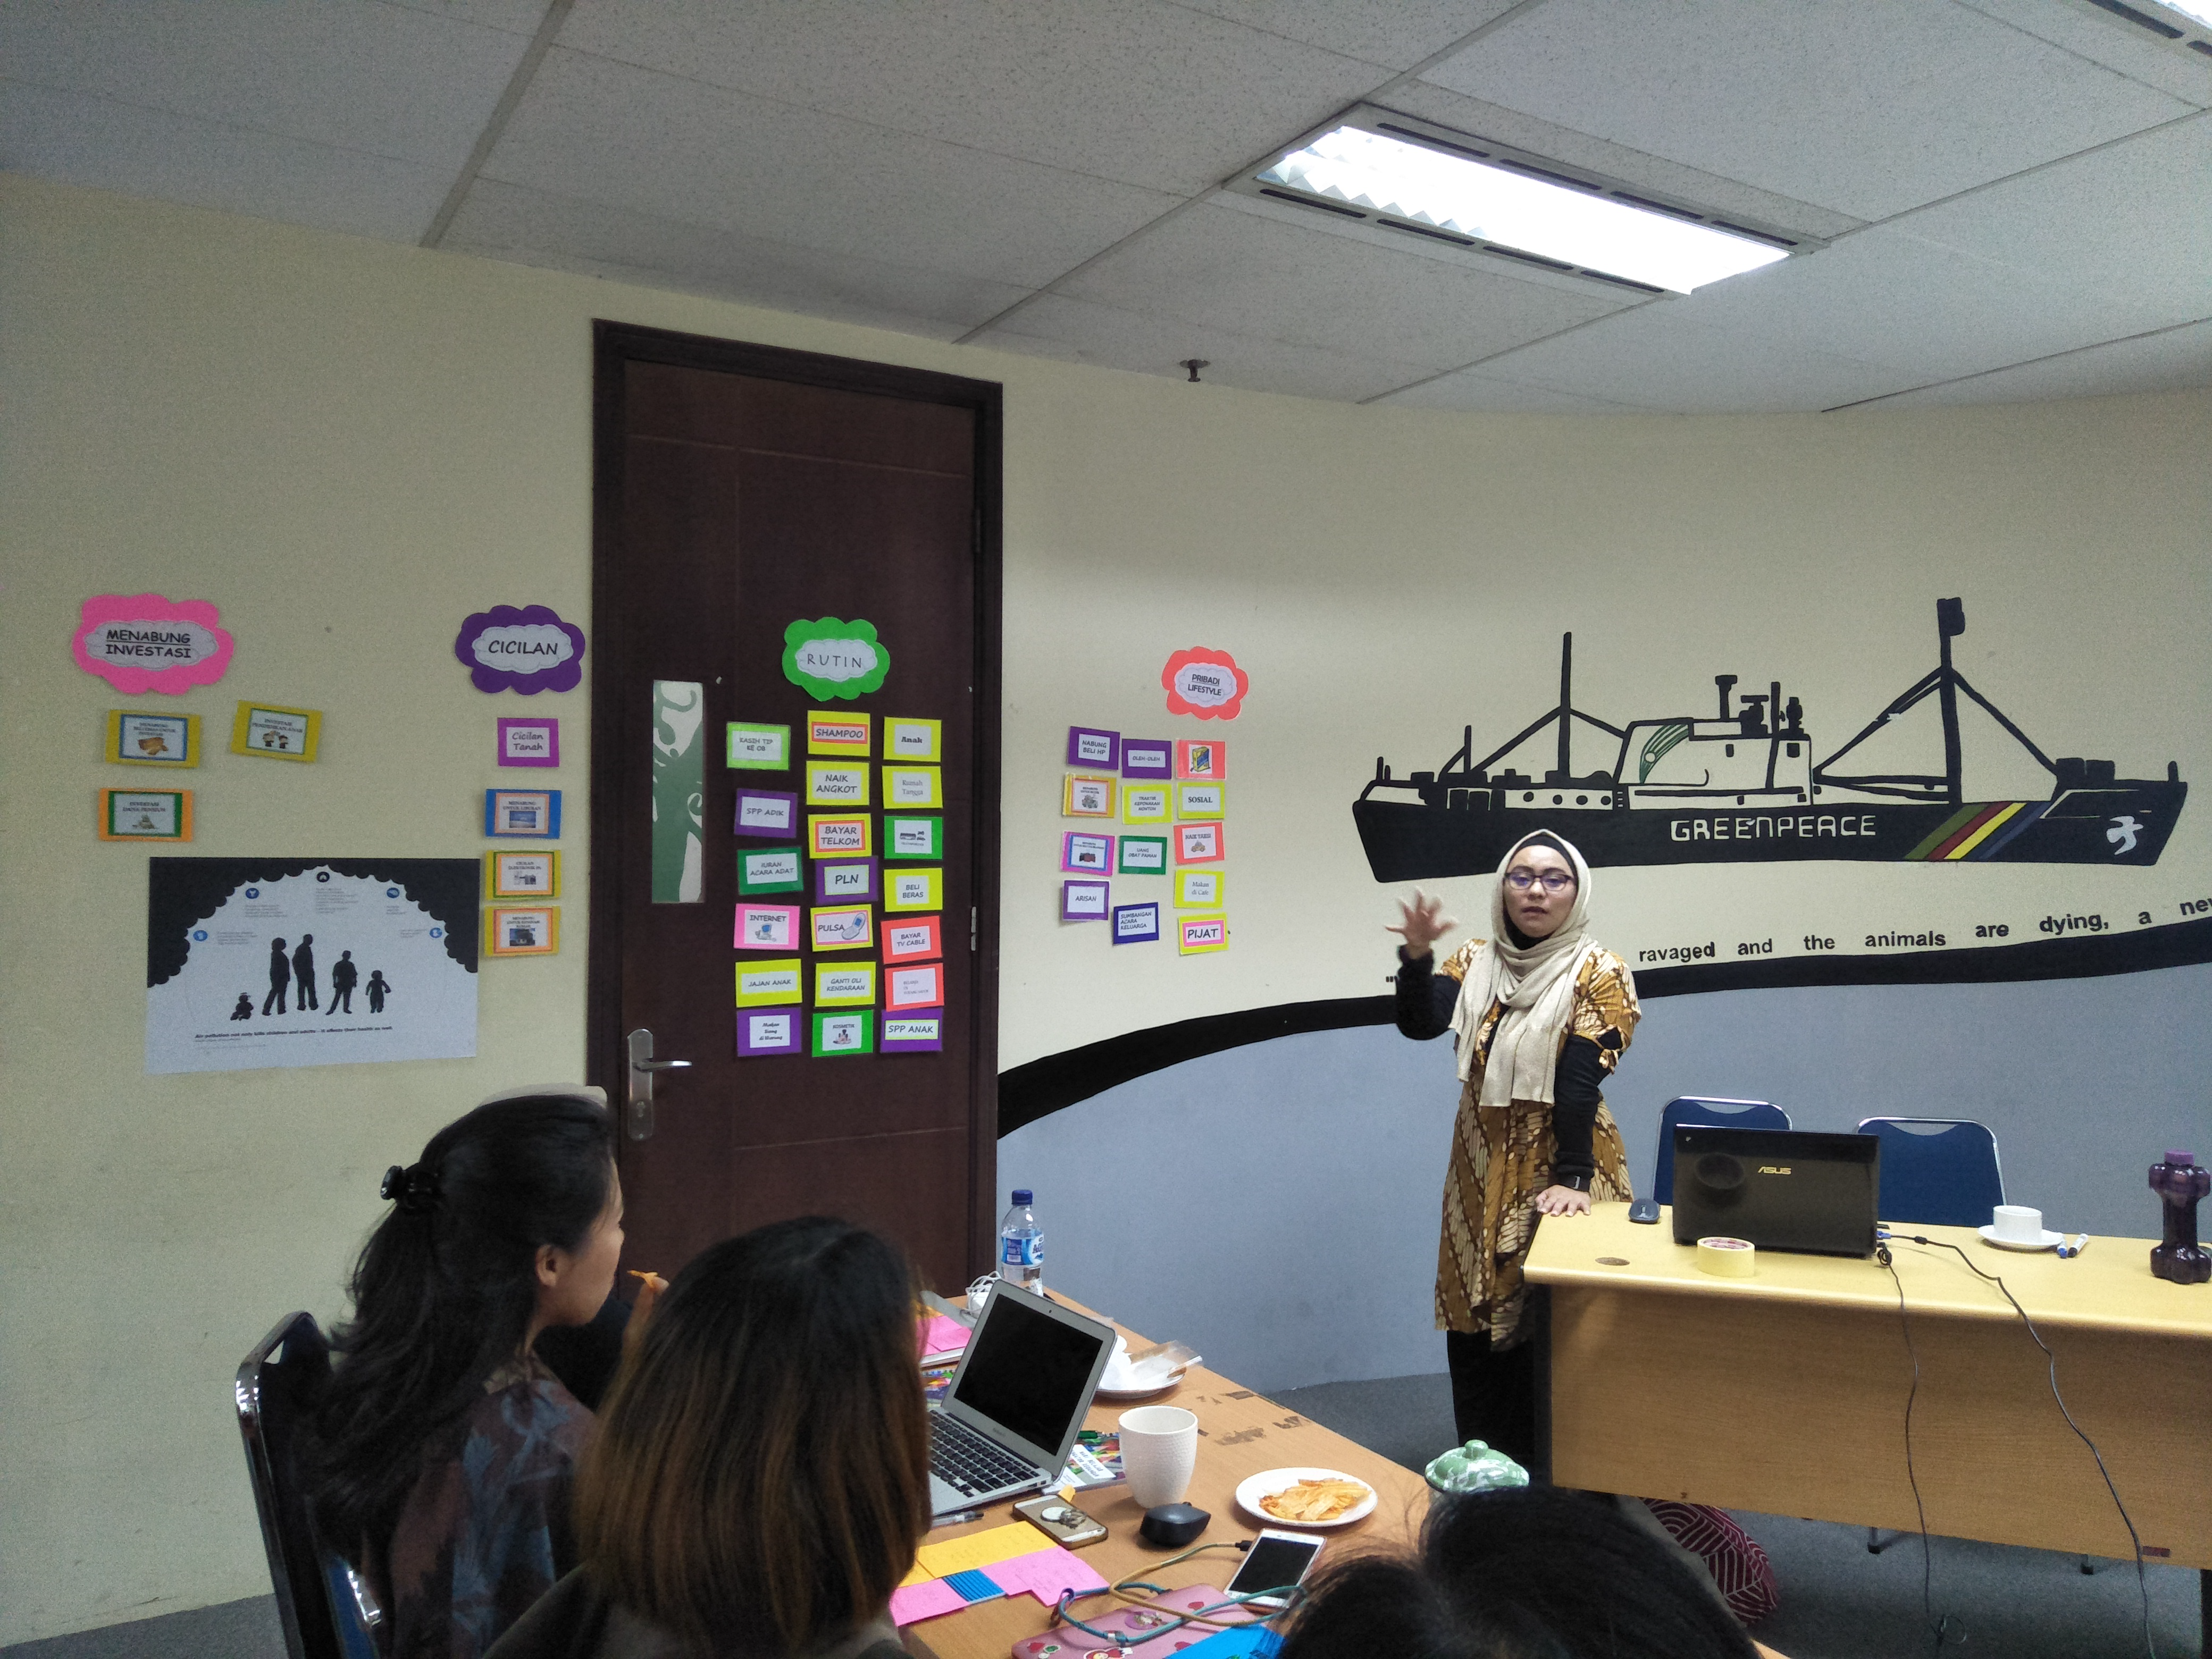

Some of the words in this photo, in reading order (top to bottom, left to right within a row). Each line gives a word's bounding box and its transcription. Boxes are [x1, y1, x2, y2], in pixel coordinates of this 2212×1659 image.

[107, 630, 191, 644] MENABUNG
[105, 644, 191, 658] INVESTASI
[489, 640, 558, 655] CICILAN
[807, 654, 862, 668] RUTIN
[1192, 674, 1220, 685] PRIBADI
[1188, 684, 1221, 696] LIFESTYLE
[512, 732, 543, 740] Cicilan
[816, 729, 864, 738] SHAMPOO
[1082, 740, 1107, 748] NABUNG
[816, 785, 857, 794] ANGKOT
[825, 826, 857, 835] BAYAR
[1671, 815, 1876, 842] GREENPEACE
[821, 837, 860, 846] TELKOM
[835, 874, 859, 885] PLN
[1187, 929, 1219, 939] PIJAT
[1639, 941, 1716, 962] ravaged
[1737, 939, 1773, 956] and
[1804, 934, 1835, 951] the
[1865, 931, 1946, 948] animals
[1975, 923, 2009, 939] are
[2040, 914, 2109, 935] dying,
[2138, 911, 2152, 925] a
[1757, 1166, 1791, 1175] ASUS
